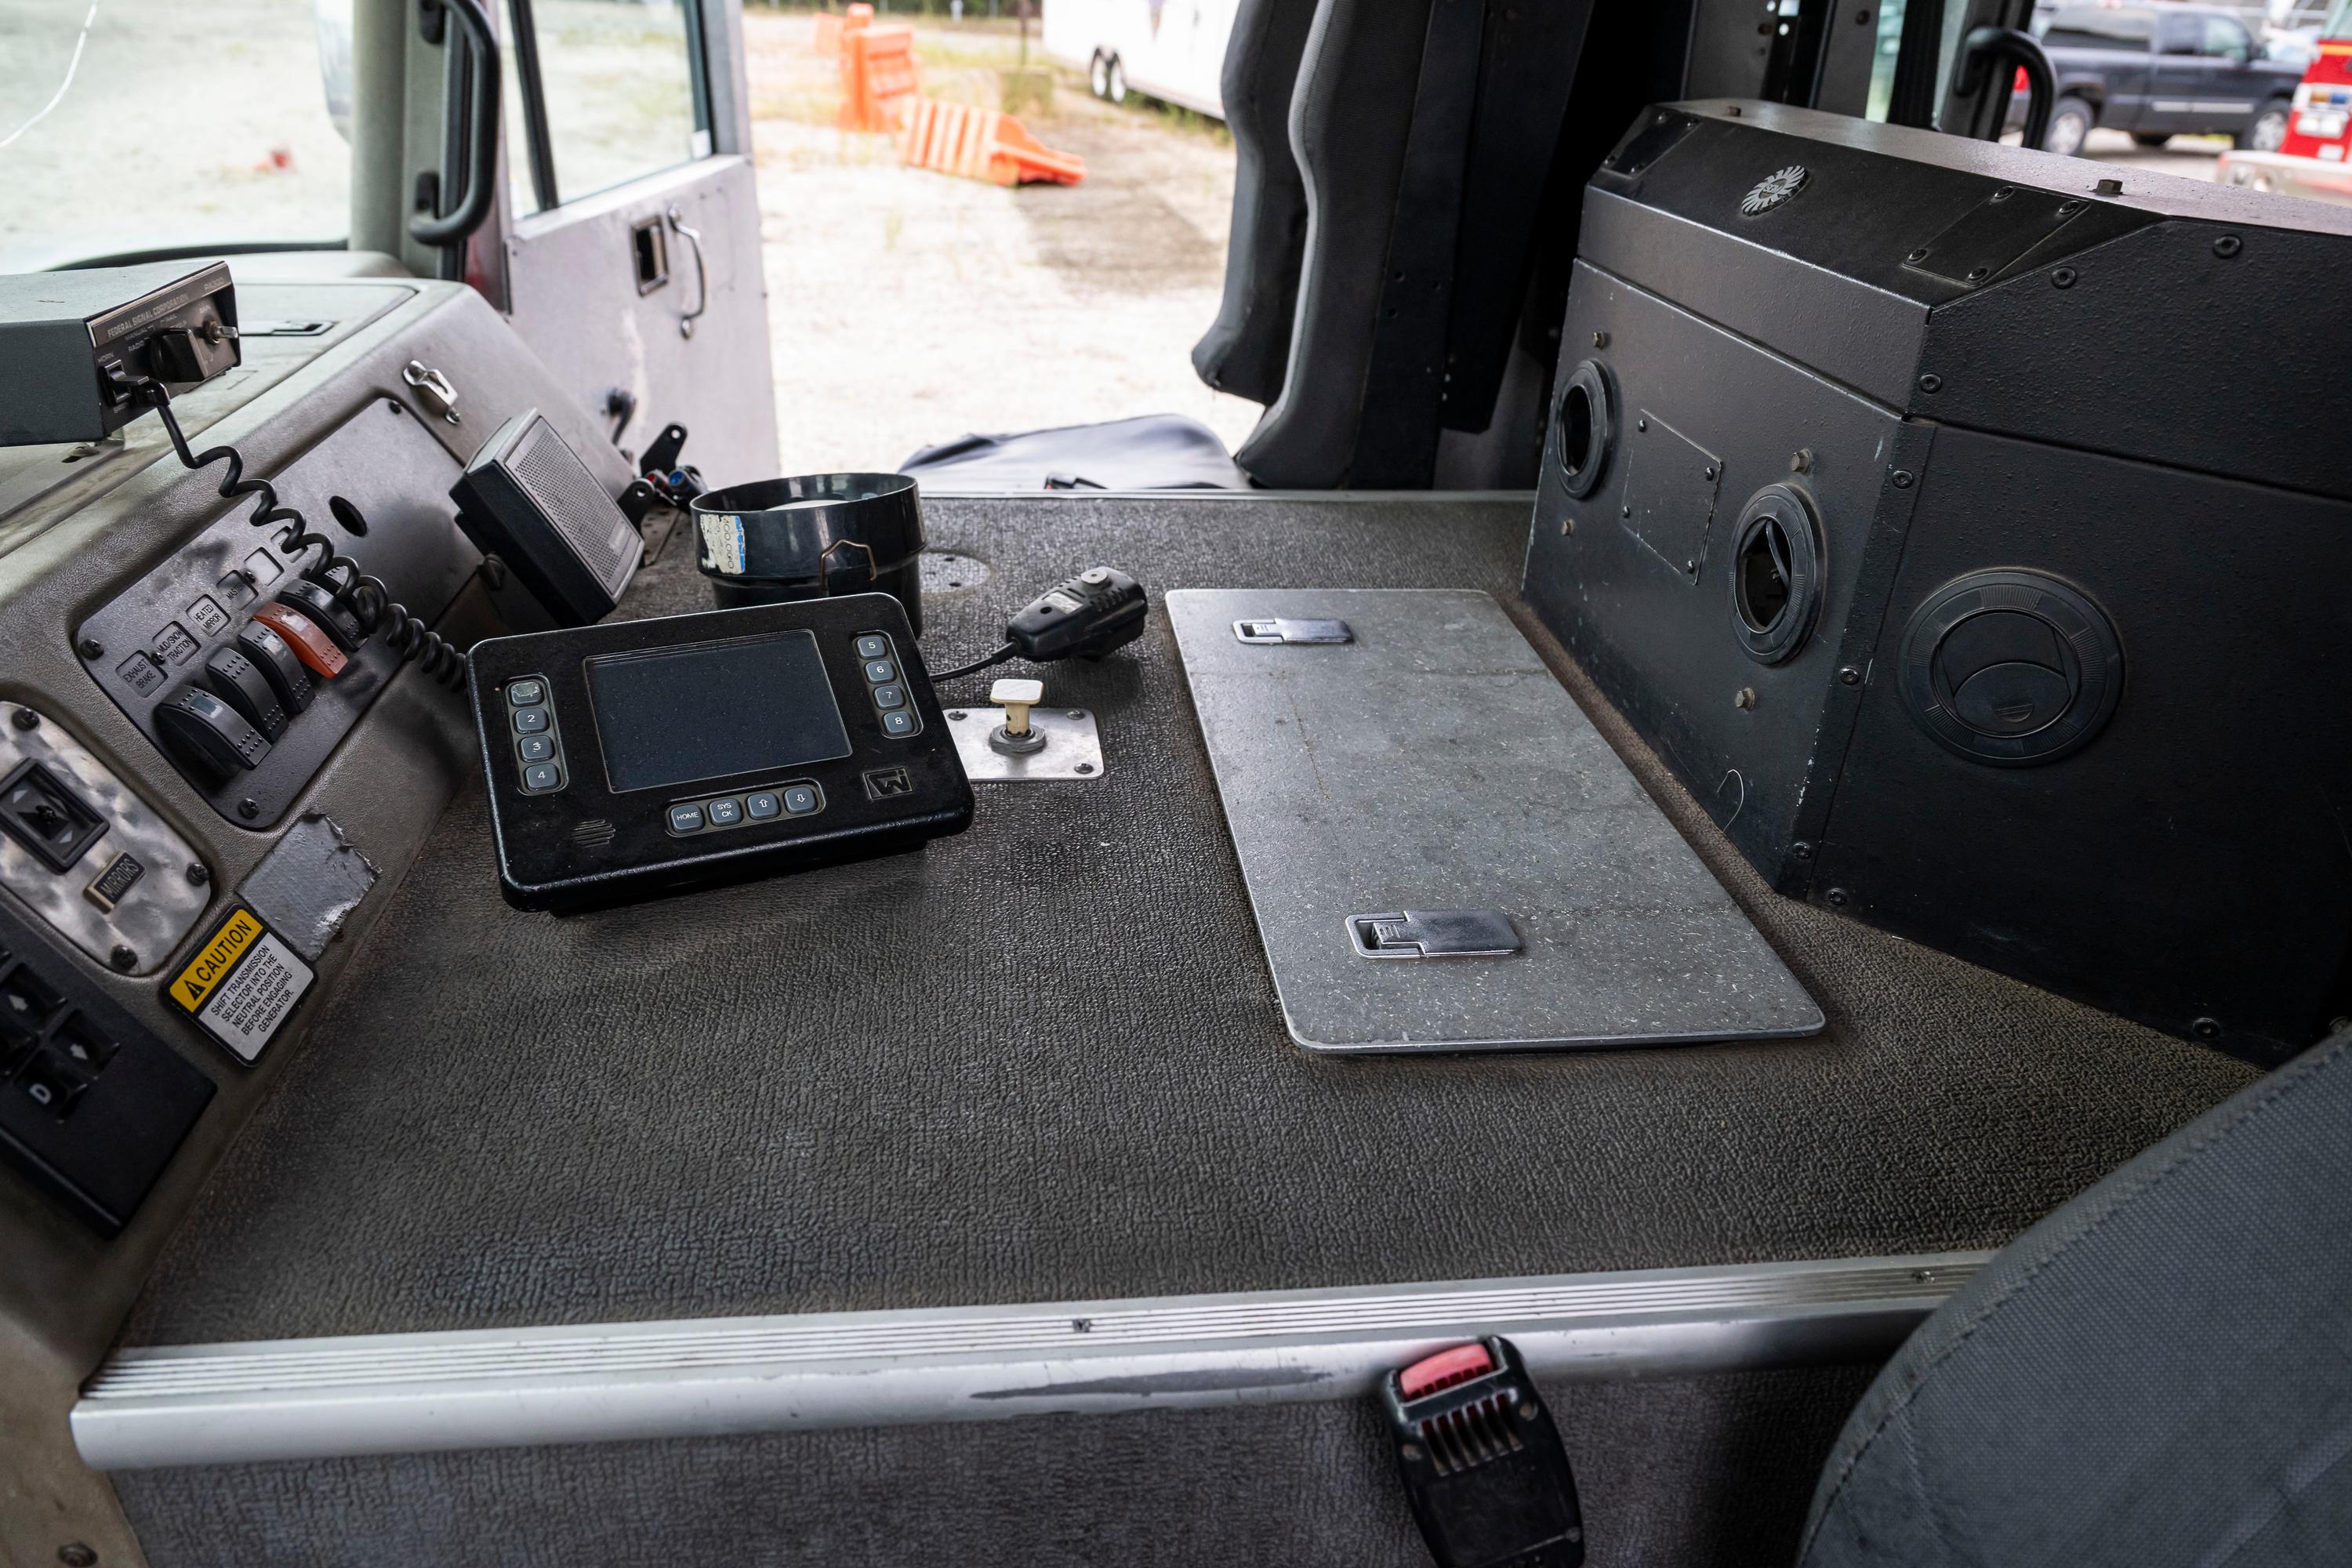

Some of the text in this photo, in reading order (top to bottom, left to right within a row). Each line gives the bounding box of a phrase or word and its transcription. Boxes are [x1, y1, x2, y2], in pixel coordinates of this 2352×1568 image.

[107, 319, 132, 338] FEDERAL
[132, 310, 154, 326] SIGNAL
[153, 293, 188, 316] CORPORATION
[125, 326, 147, 340] MANUAL
[97, 352, 114, 363] HORN
[128, 339, 145, 352] RADIO
[194, 604, 214, 622] HEATED
[202, 613, 223, 631] MIRROR
[157, 629, 184, 653] MUD/SNOW
[166, 637, 193, 661] TRACTION
[122, 658, 149, 683] EXHAUST
[136, 670, 156, 688] BRAKE
[527, 714, 535, 723] 2
[537, 771, 546, 779] 4
[676, 811, 699, 821] HOME
[100, 858, 139, 898] MIRRORS
[196, 919, 252, 982] CAUTION
[210, 945, 270, 1016] SHIFT TRANSMISSION
[221, 953, 278, 1022] SELECTOR INTO THE
[231, 963, 285, 1029] NEUTRAL POSITION
[241, 971, 292, 1036] BEFORE ENGAGING
[258, 989, 295, 1033] GENERATOR.
[29, 1083, 52, 1105] D
